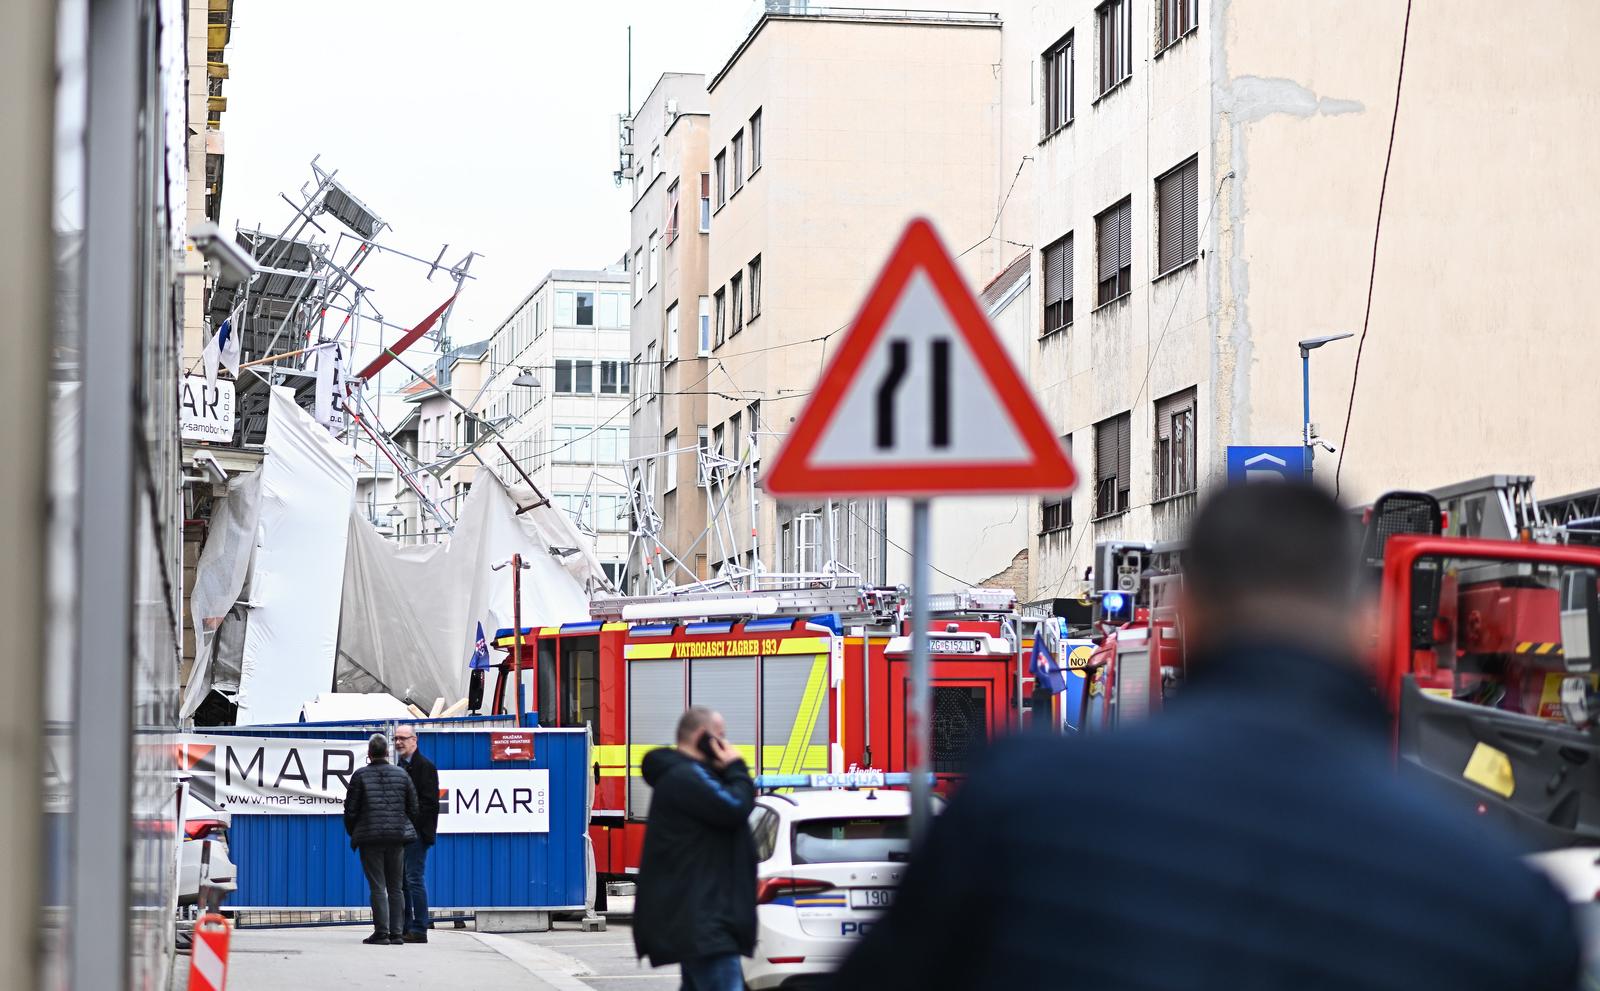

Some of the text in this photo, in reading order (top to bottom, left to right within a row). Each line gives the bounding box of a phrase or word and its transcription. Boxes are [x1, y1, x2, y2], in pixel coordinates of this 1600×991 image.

[675, 639, 777, 658] VATROGASCI ZAGREB 193
[931, 640, 941, 650] ZG
[225, 745, 356, 791] MAR
[816, 774, 880, 786] POLICIJA
[226, 794, 346, 805] www.mar-samob
[456, 788, 534, 814] MAR
